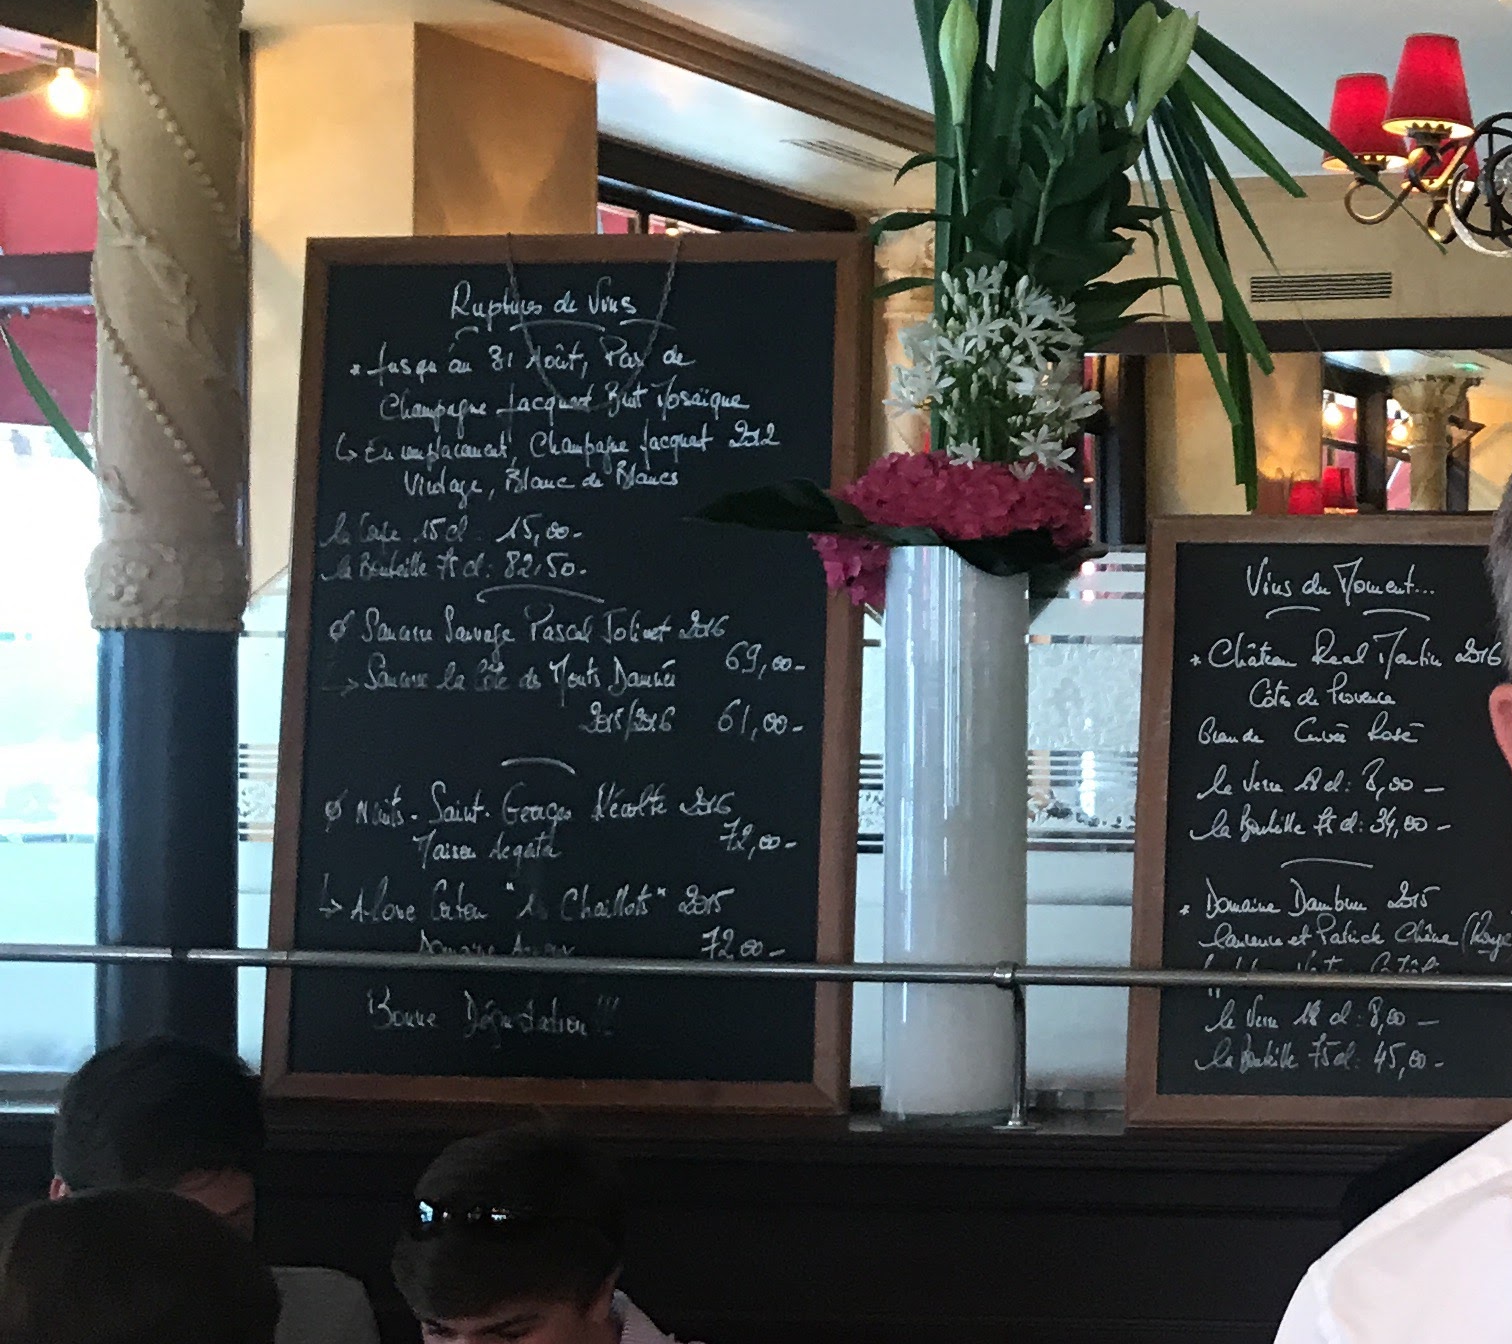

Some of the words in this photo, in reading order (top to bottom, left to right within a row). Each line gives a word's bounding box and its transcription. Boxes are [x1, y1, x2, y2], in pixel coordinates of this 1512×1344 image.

[554, 290, 578, 313] de
[588, 276, 637, 315] Vins
[489, 345, 512, 370] 31
[663, 344, 697, 366] de
[380, 389, 486, 439] Champagne
[604, 382, 648, 418] Brut
[530, 430, 630, 474] Champagne
[729, 419, 780, 448] 2012
[582, 470, 604, 488] de
[1246, 556, 1292, 597] Vins
[1301, 571, 1331, 595] du
[524, 604, 593, 643] Pascal
[680, 609, 730, 640] 2016
[1207, 631, 1297, 668] Château
[1372, 626, 1442, 680] Martin
[1454, 637, 1502, 666] 2016
[1297, 686, 1320, 706] de
[1326, 670, 1397, 706] Provence
[1366, 711, 1425, 743] Rosé
[1206, 876, 1280, 918] Domaine
[1386, 880, 1441, 909] 2015
[1287, 923, 1313, 946] et
[1316, 912, 1384, 946] Patrick
